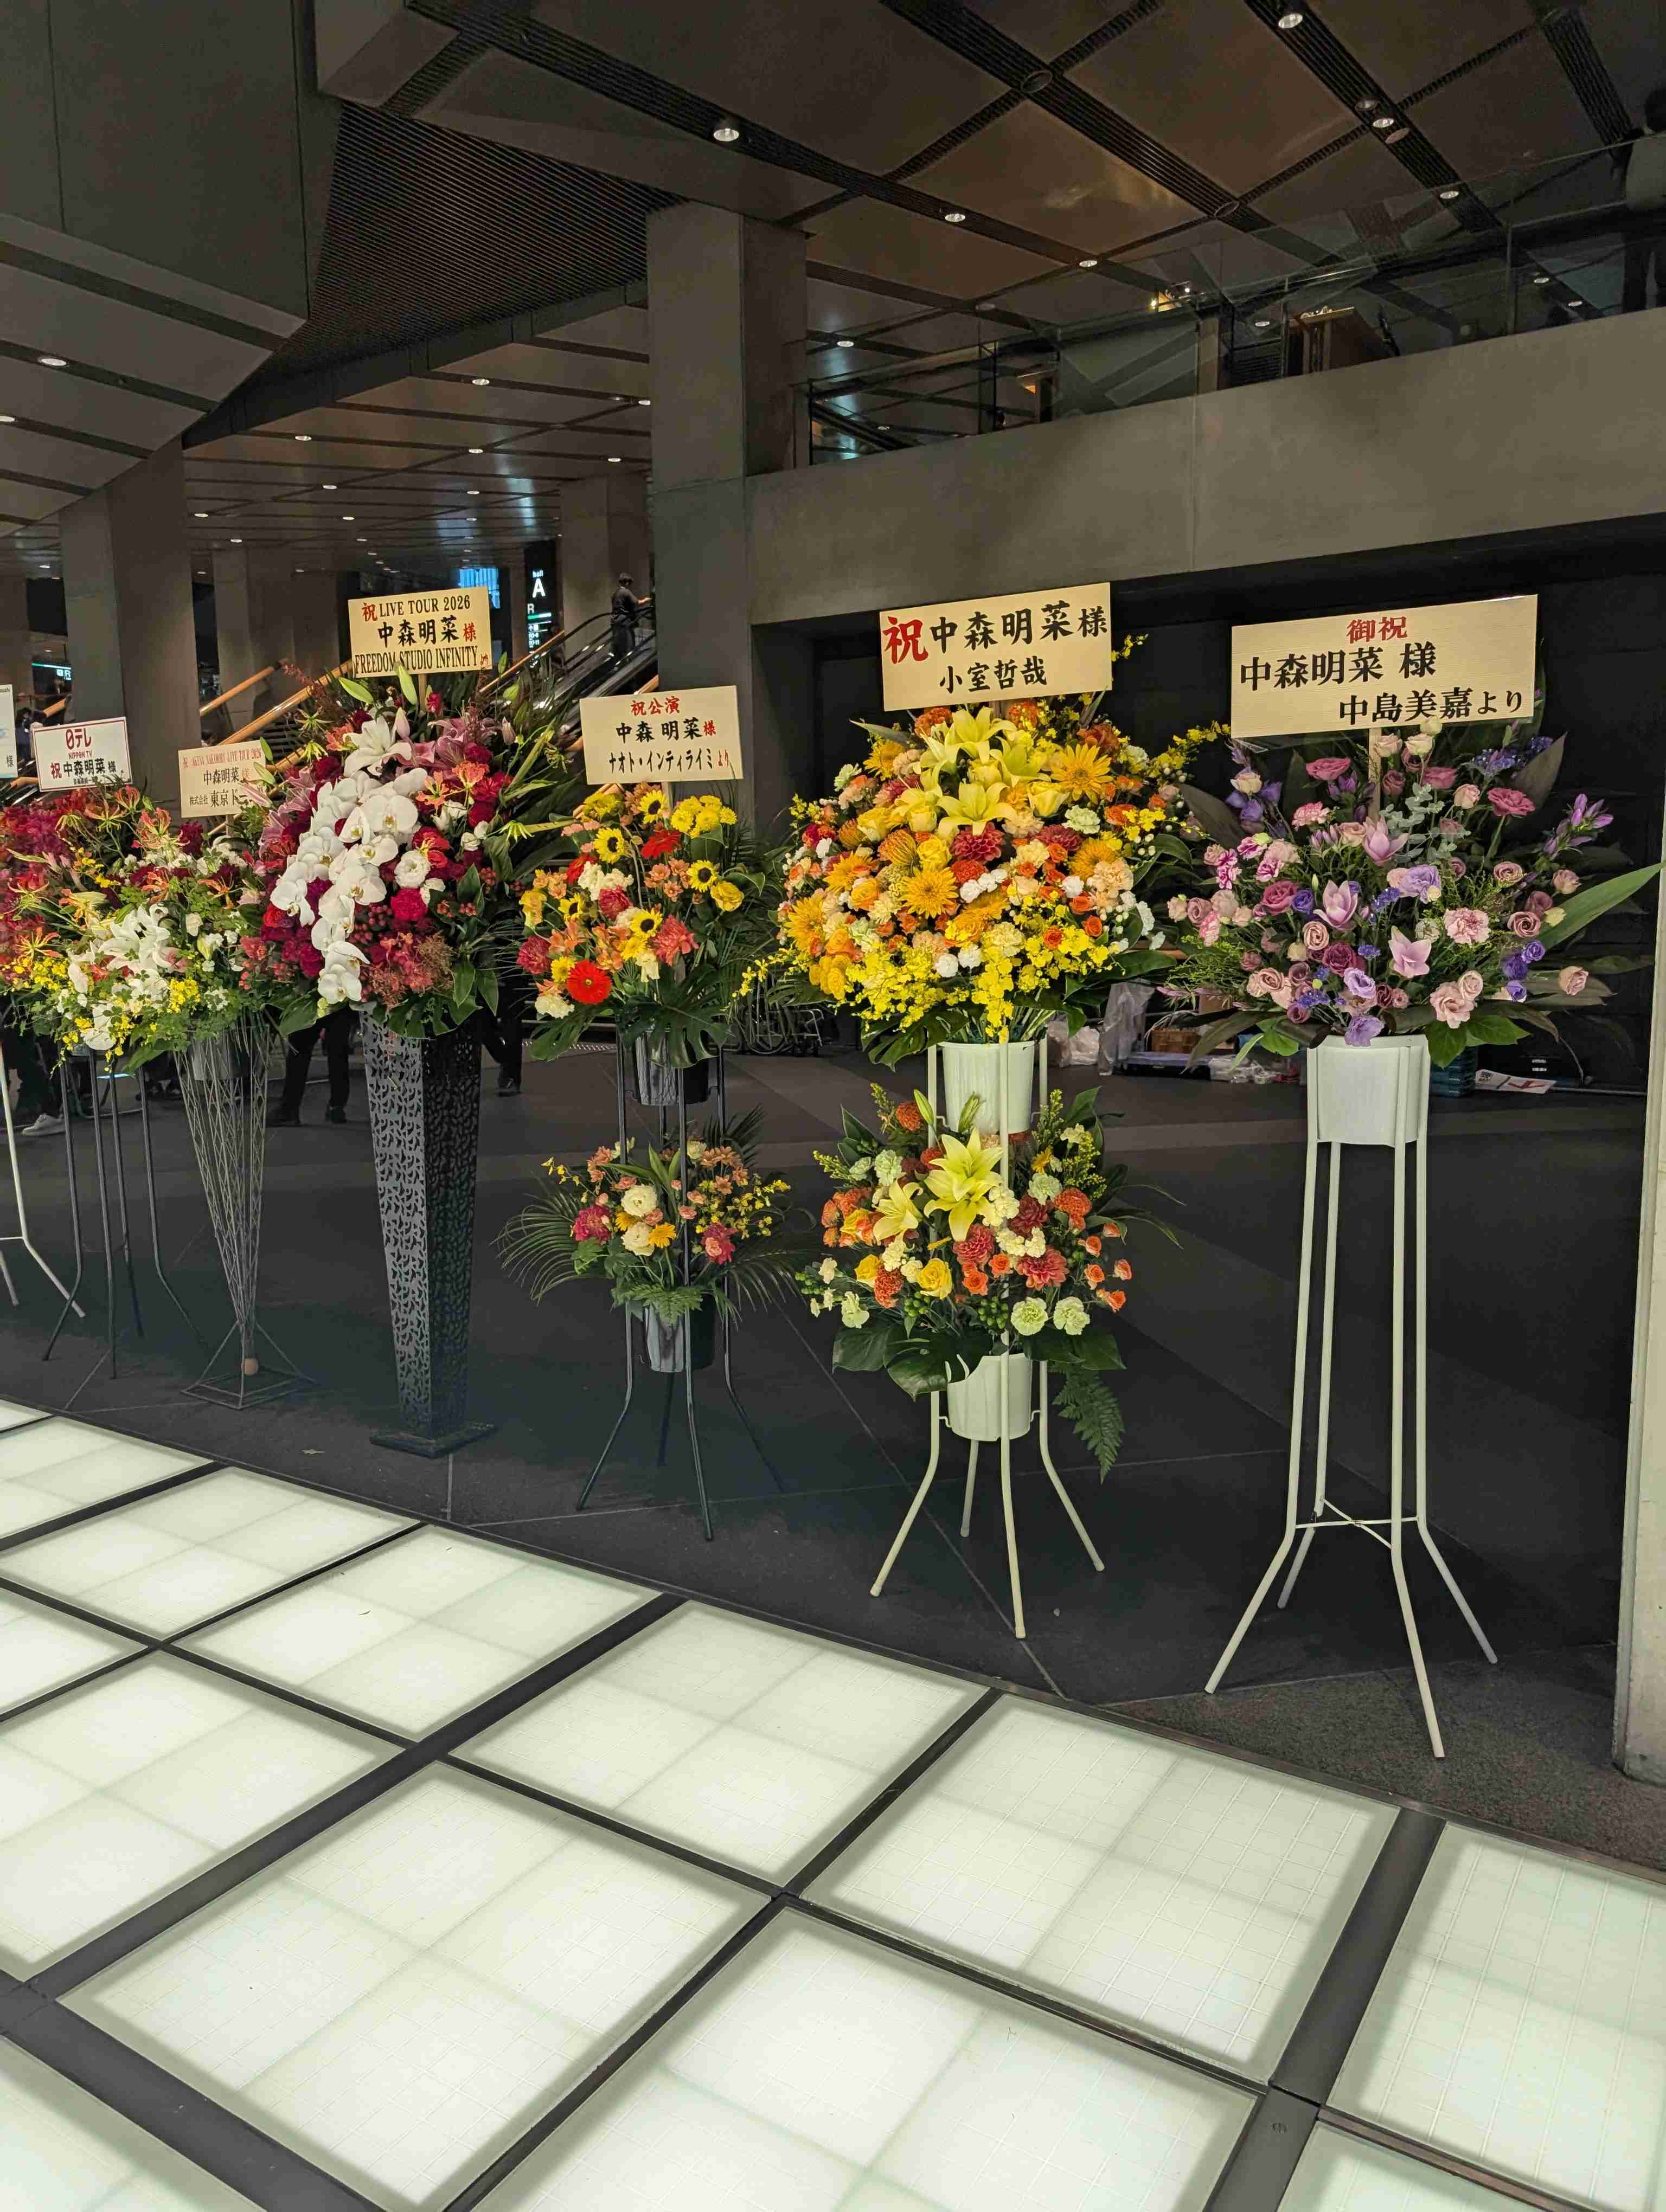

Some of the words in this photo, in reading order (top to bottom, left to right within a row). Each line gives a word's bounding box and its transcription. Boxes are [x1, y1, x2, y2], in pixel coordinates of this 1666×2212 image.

[533, 578, 546, 597] A
[362, 602, 378, 622] 祝
[380, 602, 404, 617] LIVE
[408, 598, 439, 614] TOUR
[444, 595, 470, 611] 2026
[527, 603, 534, 614] R
[1346, 616, 1408, 644] 御祝
[355, 652, 397, 674] FREEDOM
[399, 649, 433, 671] STUDIO
[435, 646, 478, 668] INFINITY
[939, 655, 1047, 694] 小室哲哉
[631, 696, 680, 716] 祝公演
[1339, 686, 1522, 725] 中島美嘉より
